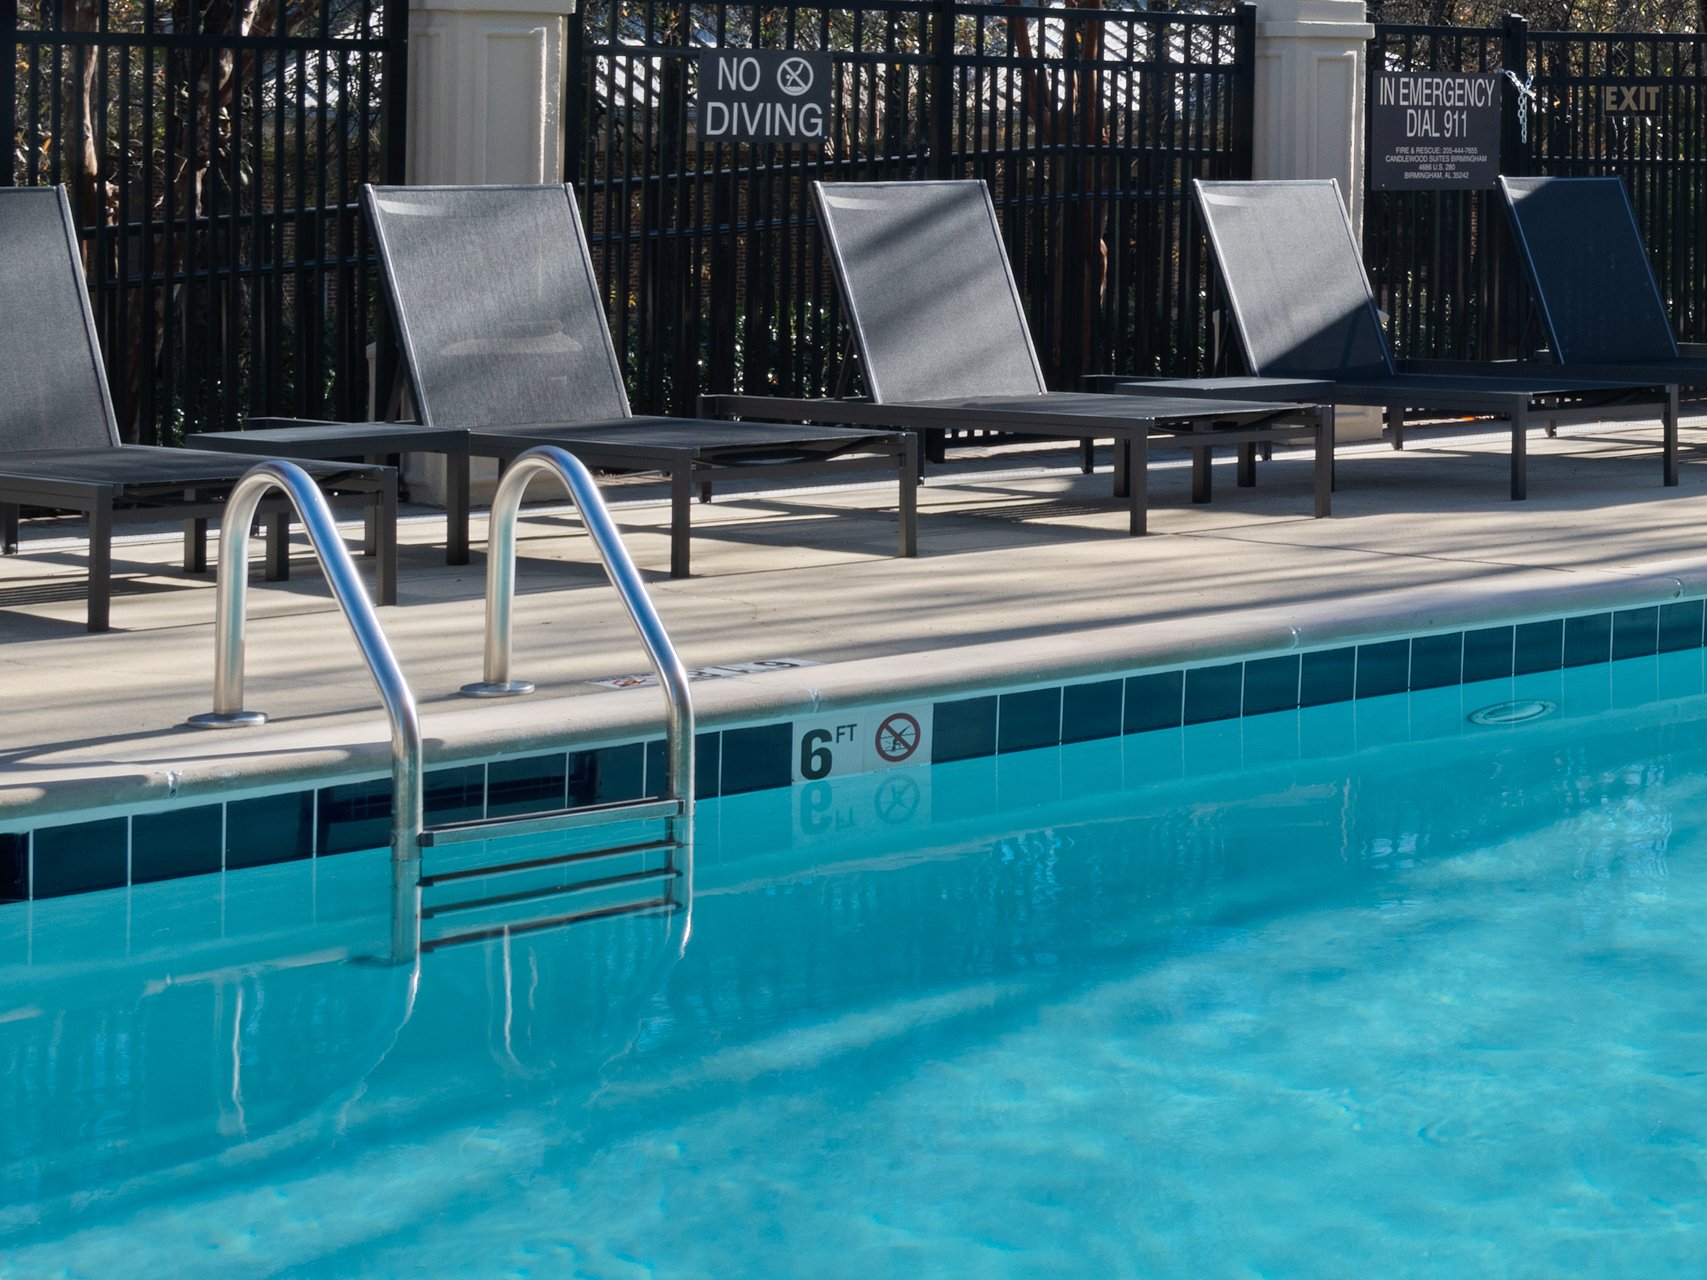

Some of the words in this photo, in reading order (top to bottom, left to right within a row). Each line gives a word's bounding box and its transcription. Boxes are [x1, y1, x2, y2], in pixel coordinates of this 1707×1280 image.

[718, 57, 760, 91] NO
[1380, 77, 1394, 105] IN
[1400, 78, 1495, 107] EMERGENCY
[1605, 86, 1659, 111] EXIT
[706, 102, 822, 136] DIVING
[1407, 110, 1440, 137] DIAL
[1444, 111, 1467, 138] 911
